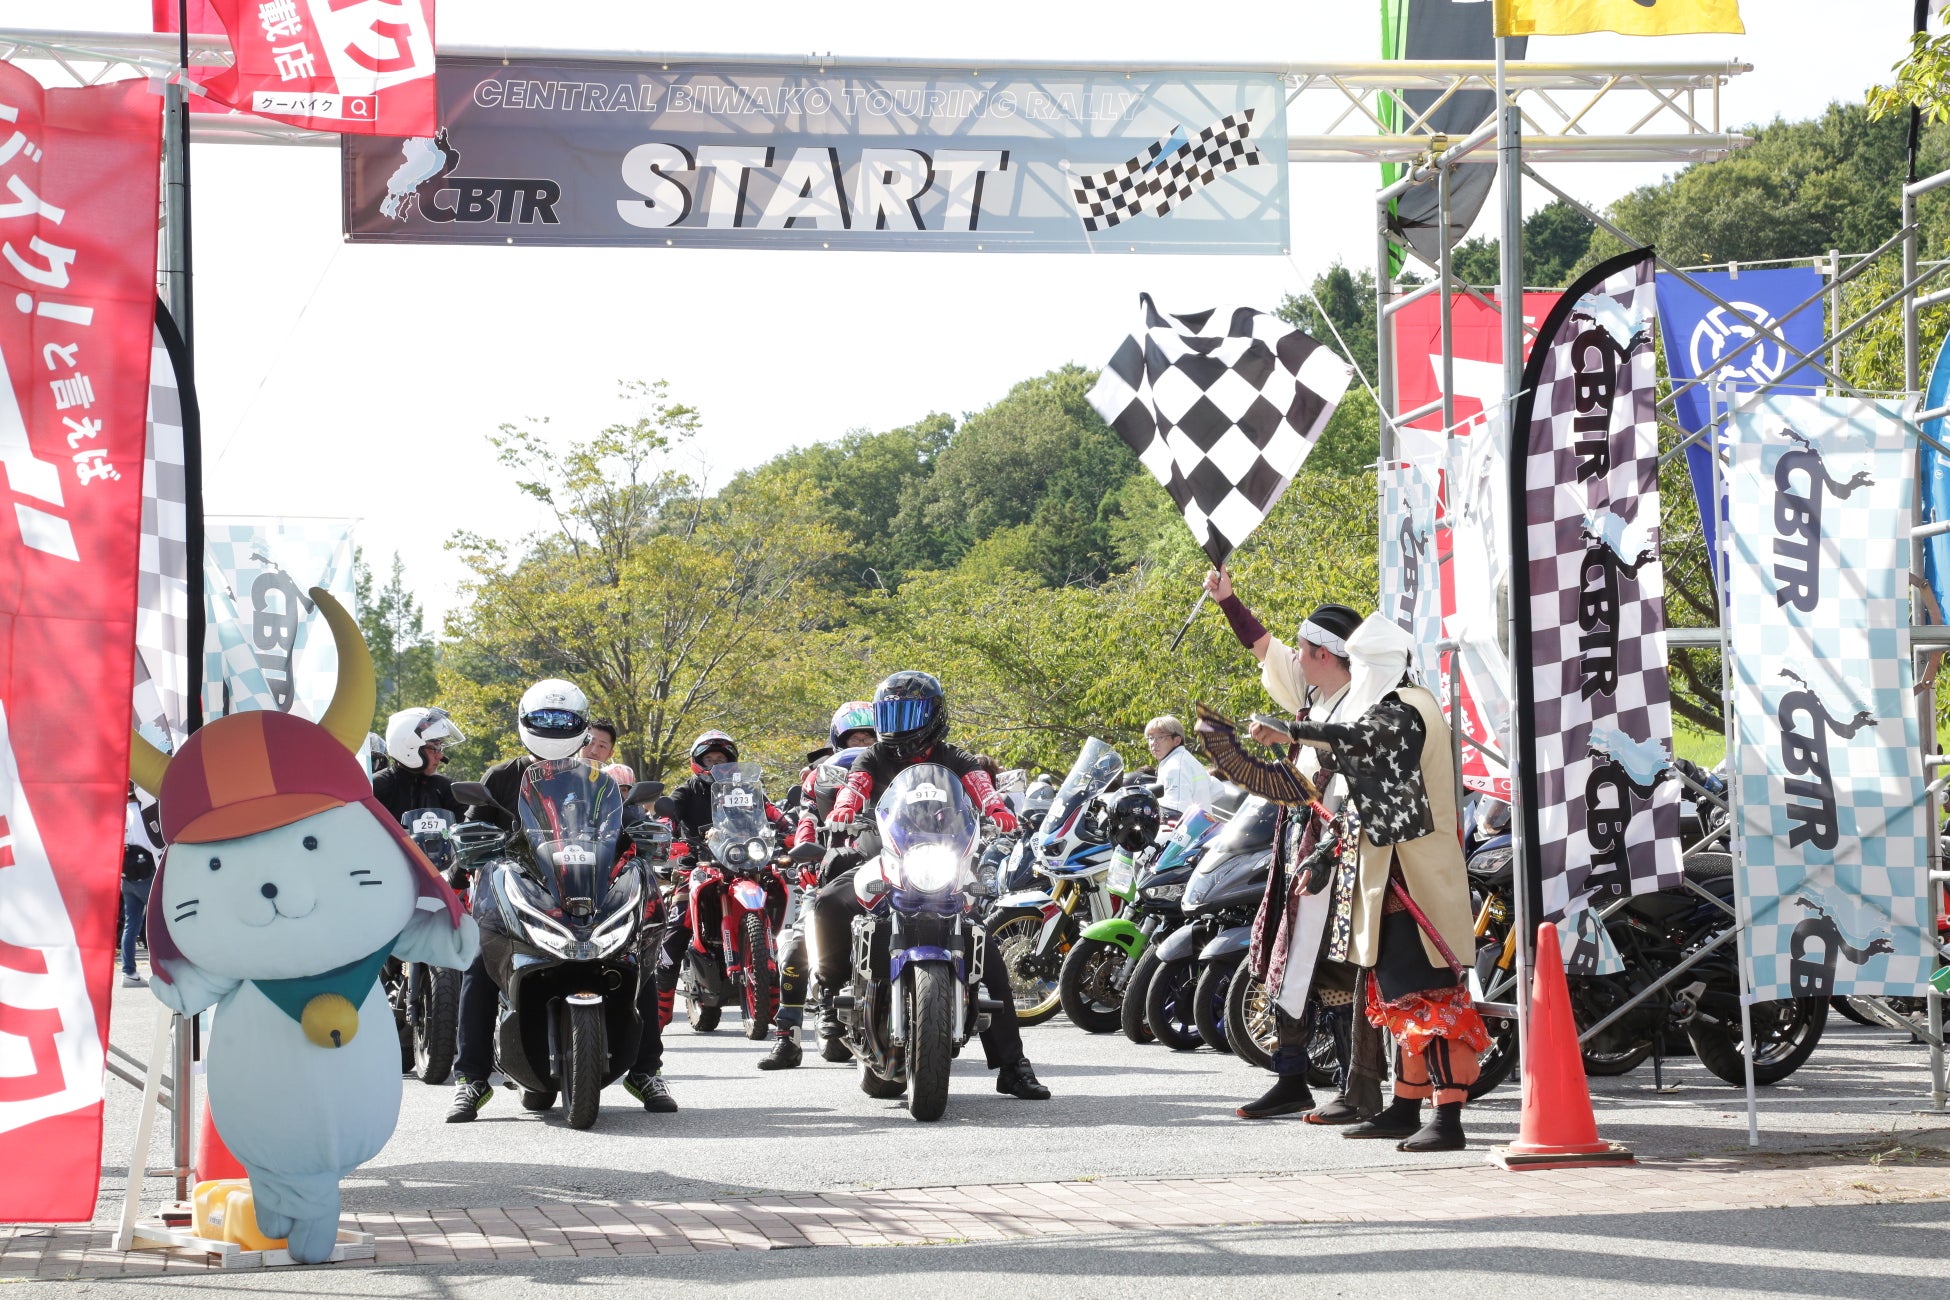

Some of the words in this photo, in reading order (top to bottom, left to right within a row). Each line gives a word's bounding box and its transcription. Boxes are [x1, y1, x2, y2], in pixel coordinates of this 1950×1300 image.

[261, 97, 333, 113] グーバイク
[473, 78, 657, 113] CENTRAL
[665, 83, 833, 117] BIWAKO
[840, 87, 1019, 119] TOURING
[1025, 91, 1146, 121] RALLY
[416, 177, 562, 225] CBTR
[616, 141, 1011, 231] START
[1570, 328, 1617, 485] CBTR
[1773, 449, 1824, 613] CBTR
[1579, 546, 1621, 704] CBTR
[1778, 689, 1839, 851] CBTR
[728, 796, 750, 806] 1273
[916, 790, 938, 799] 917
[421, 820, 440, 831] 257
[563, 854, 586, 862] 916
